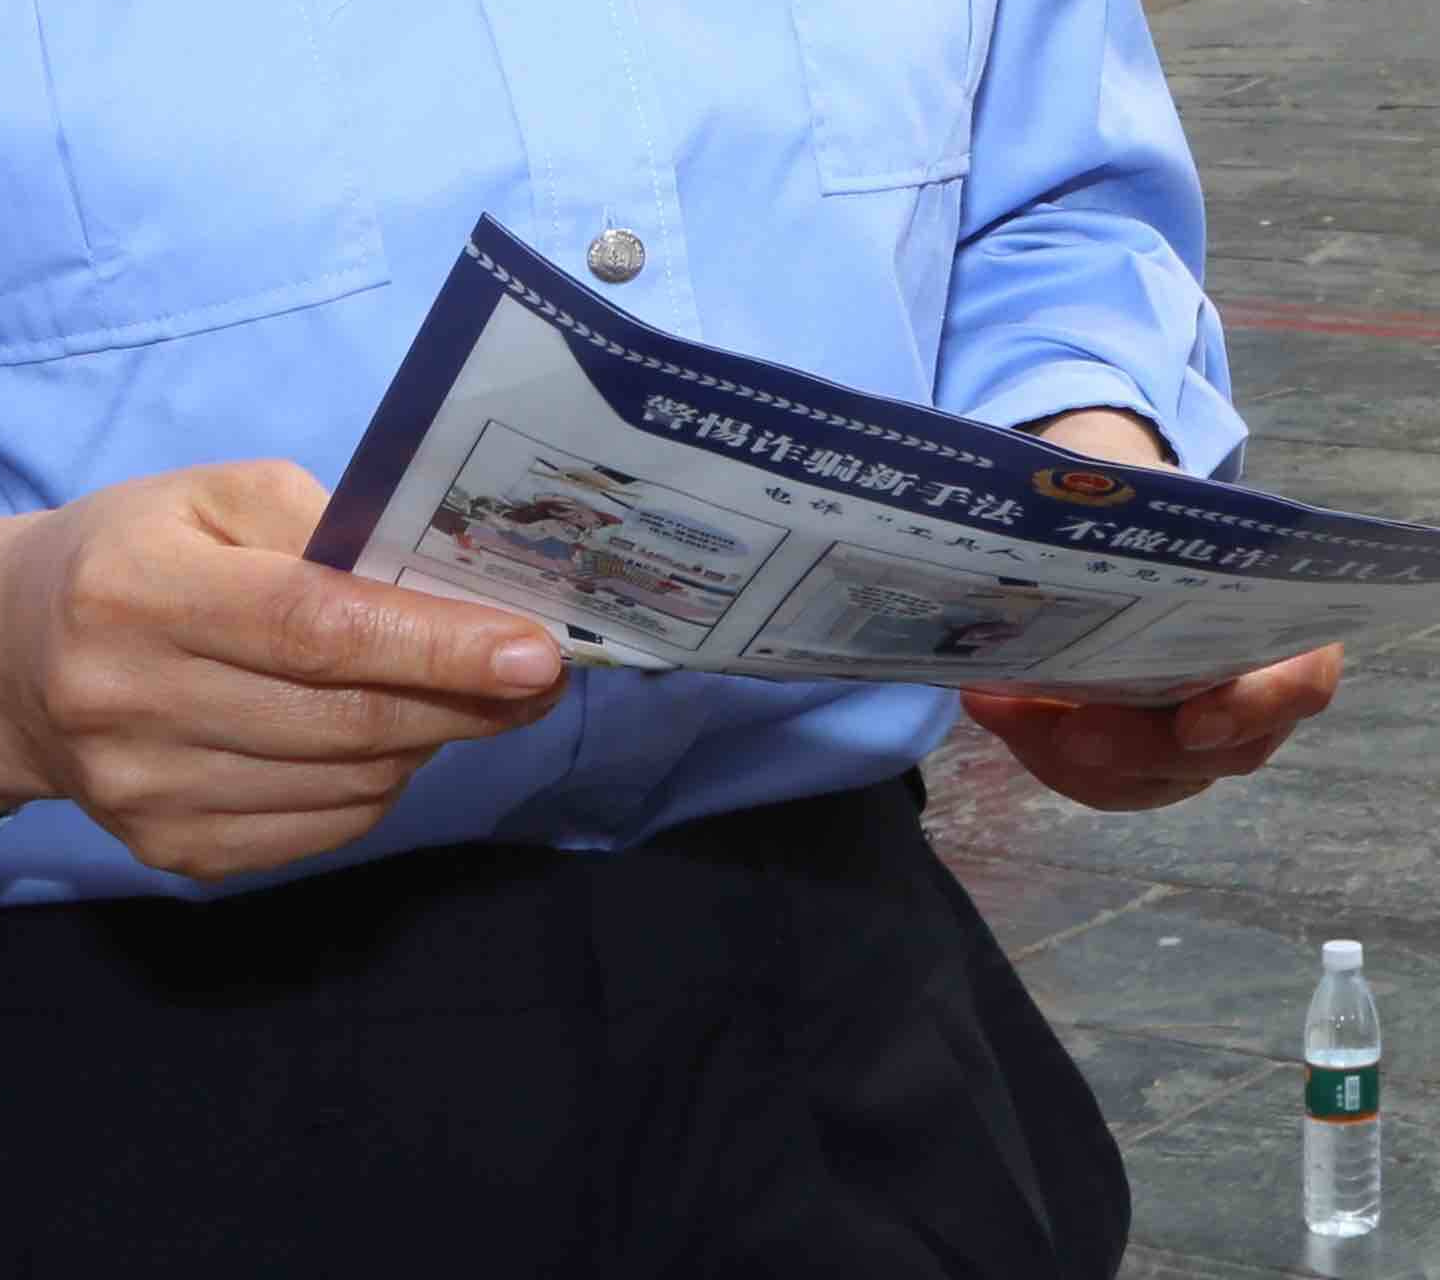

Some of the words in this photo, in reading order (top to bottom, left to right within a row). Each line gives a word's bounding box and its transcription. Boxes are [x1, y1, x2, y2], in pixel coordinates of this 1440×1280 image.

[641, 391, 1025, 527] 警惕诈骗新手法
